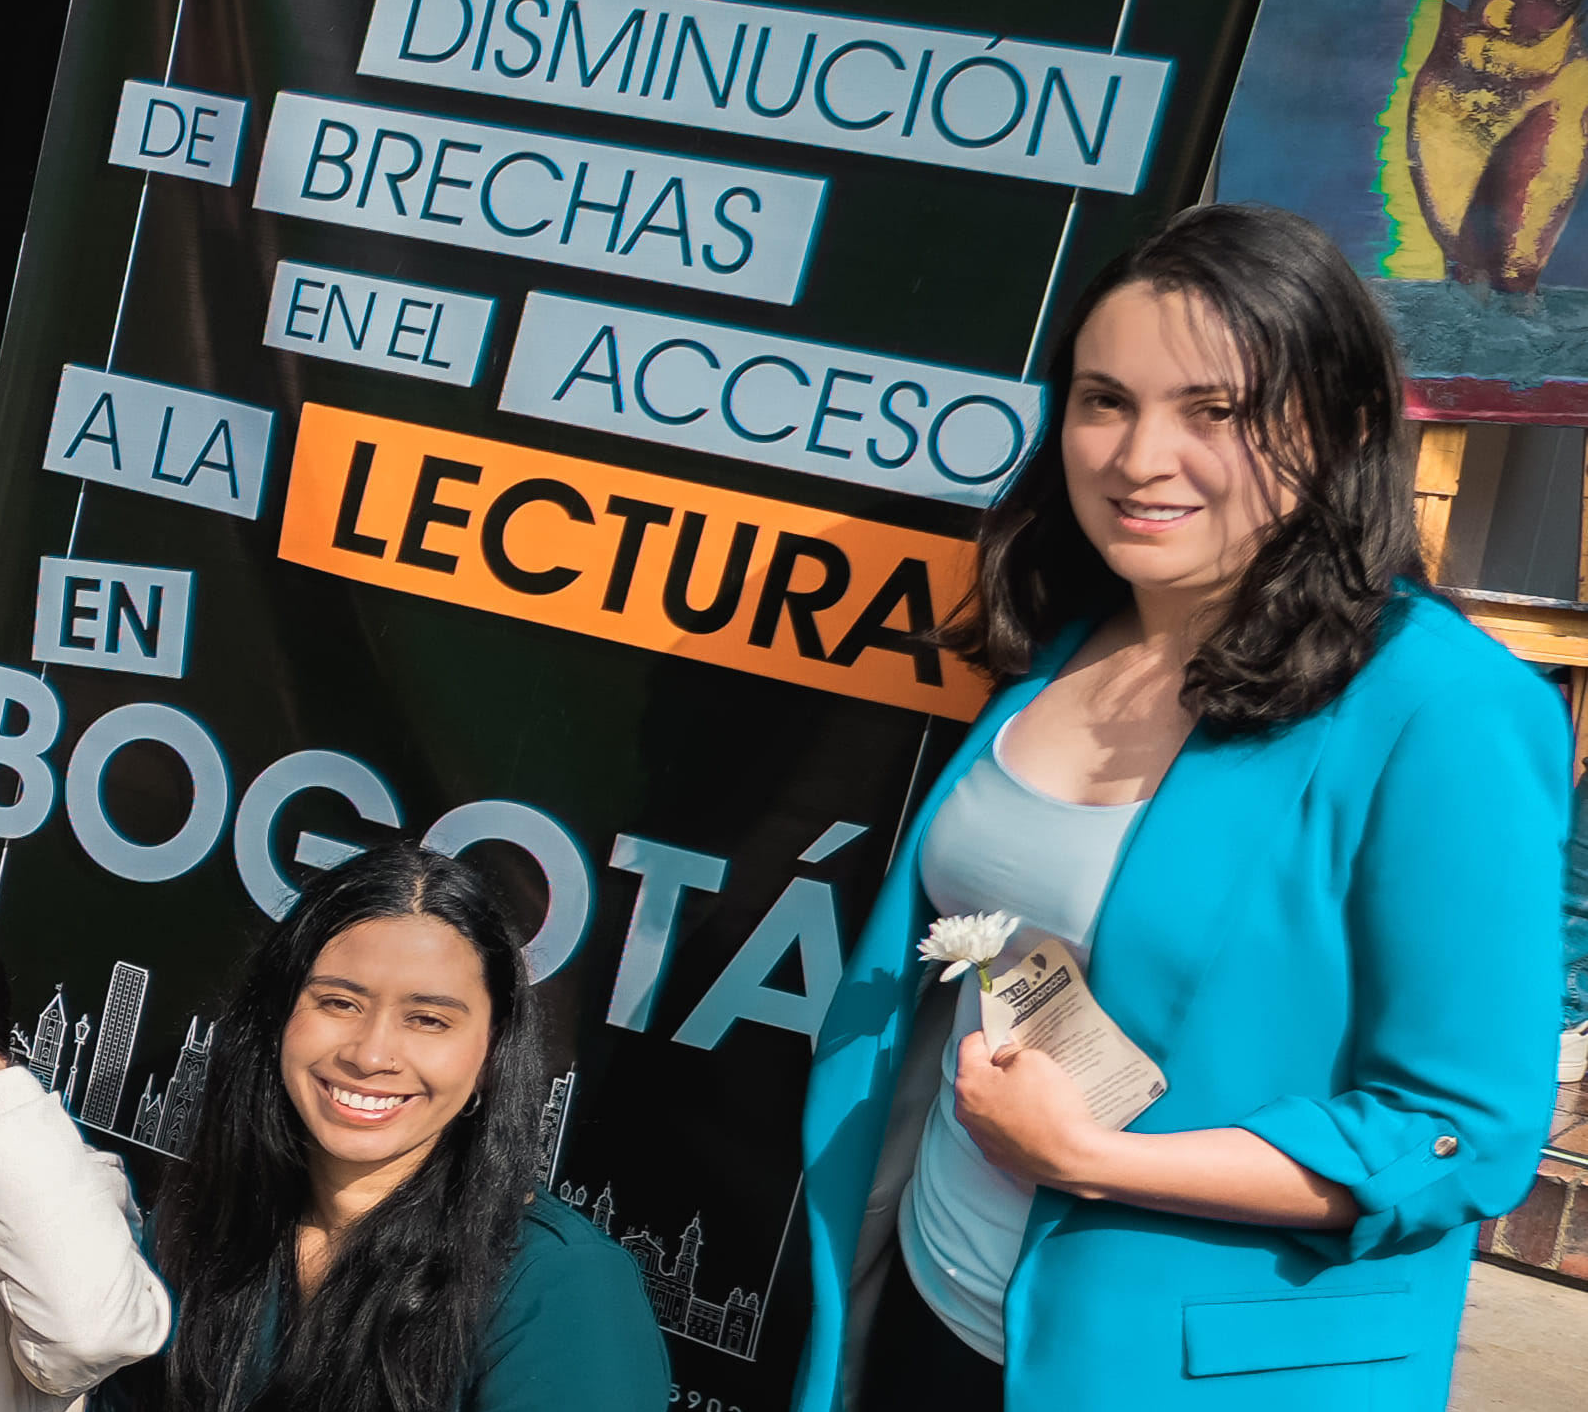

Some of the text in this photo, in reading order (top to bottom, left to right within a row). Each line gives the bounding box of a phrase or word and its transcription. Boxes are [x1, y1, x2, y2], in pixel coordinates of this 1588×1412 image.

[138, 97, 762, 275] DE BRECHAS
[62, 391, 241, 499] A LA
[283, 279, 1025, 486] EN EL ACCESO
[59, 575, 164, 658] EN
[329, 440, 946, 687] LECTURA
